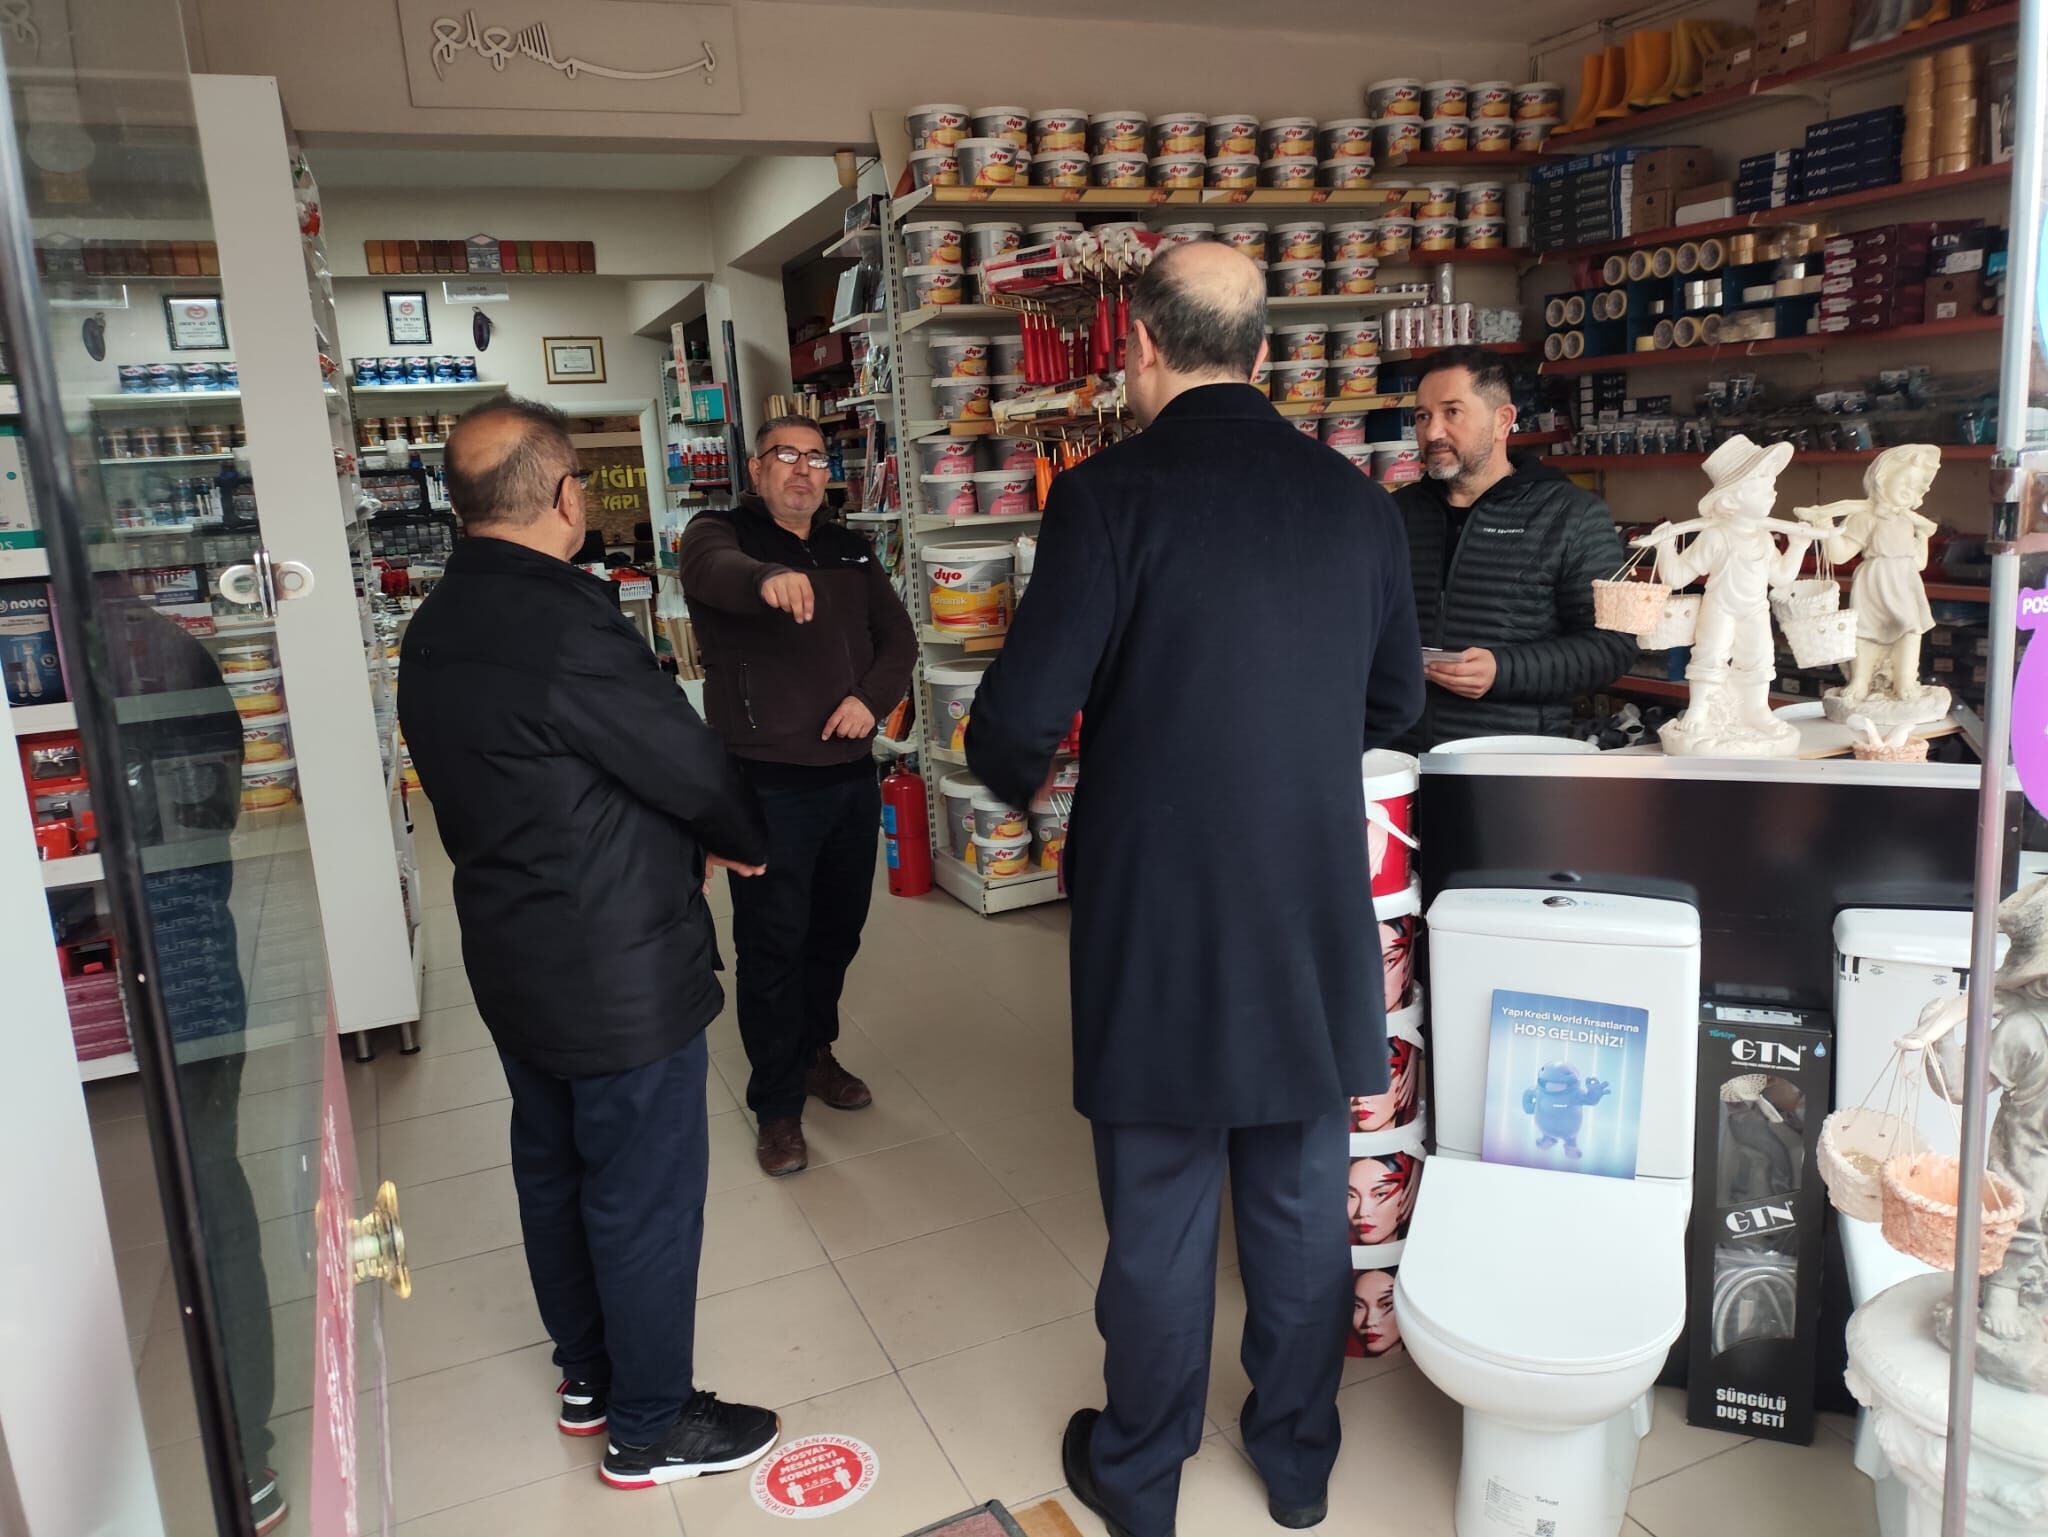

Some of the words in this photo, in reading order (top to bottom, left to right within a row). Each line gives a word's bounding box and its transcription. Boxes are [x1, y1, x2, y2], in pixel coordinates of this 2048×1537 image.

[1395, 89, 1412, 98] dyo
[1445, 89, 1461, 98] dyo
[1486, 91, 1502, 99] dyo
[939, 115, 957, 126] dyo
[1006, 118, 1023, 128] dyo
[1047, 120, 1066, 131] dyo
[1116, 122, 1134, 132] dyo
[1171, 124, 1189, 134] dyo
[1232, 125, 1249, 135] dyo
[1401, 126, 1416, 135] dyo
[1445, 127, 1461, 136] dyo
[1482, 128, 1499, 136] dyo
[1285, 128, 1302, 138] dyo
[1348, 128, 1364, 138] dyo
[990, 152, 1008, 162] dyo
[1060, 162, 1078, 172] dyo
[1118, 163, 1135, 173] dyo
[1170, 165, 1188, 175] dyo
[1221, 166, 1239, 176] dyo
[1290, 165, 1306, 176] dyo
[1351, 166, 1367, 176] dyo
[1348, 230, 1366, 241] dyo
[1386, 227, 1402, 235] dyo
[1427, 227, 1444, 236] dyo
[1475, 227, 1492, 235] dyo
[1056, 233, 1072, 242] dyo
[1233, 232, 1250, 243] dyo
[1294, 231, 1311, 242] dyo
[1302, 269, 1317, 280] dyo
[1352, 268, 1368, 278] dyo
[934, 276, 951, 286] dyo
[1305, 333, 1319, 343] dyo
[1357, 331, 1372, 341] dyo
[965, 347, 982, 356] dyo
[1301, 369, 1316, 379] dyo
[1353, 367, 1369, 377] dyo
[1016, 385, 1033, 393] dyo
[1300, 422, 1313, 431] dyo
[1338, 419, 1354, 428] dyo
[946, 445, 964, 454] dyo
[1016, 441, 1033, 450] dyo
[1398, 451, 1414, 460] dyo
[1004, 483, 1022, 492] dyo
[602, 495, 640, 511] YAPI
[934, 568, 962, 584] dyo
[10, 598, 47, 610] nova
[995, 850, 1013, 858] dyo
[1502, 1006, 1524, 1018] Yapı
[1525, 1008, 1550, 1021] Kredi
[1553, 1013, 1582, 1025] World
[1584, 1016, 1640, 1033] fırsatlarına
[1514, 1023, 1545, 1038] HOŞ
[1548, 1028, 1624, 1048] GELDİNİZ!
[1731, 1039, 1801, 1066] GTN
[1726, 1202, 1794, 1232] GTN
[1716, 1387, 1787, 1412] SÜRGÜLÜ
[1716, 1405, 1747, 1424] DUŞ
[1752, 1411, 1784, 1428] SETİ
[783, 1445, 827, 1464] SOSYAL
[780, 1449, 837, 1475] MESAFEYİ
[775, 1446, 791, 1456] VE
[860, 1464, 874, 1491] ODASI
[779, 1457, 846, 1484] KORUYALIM
